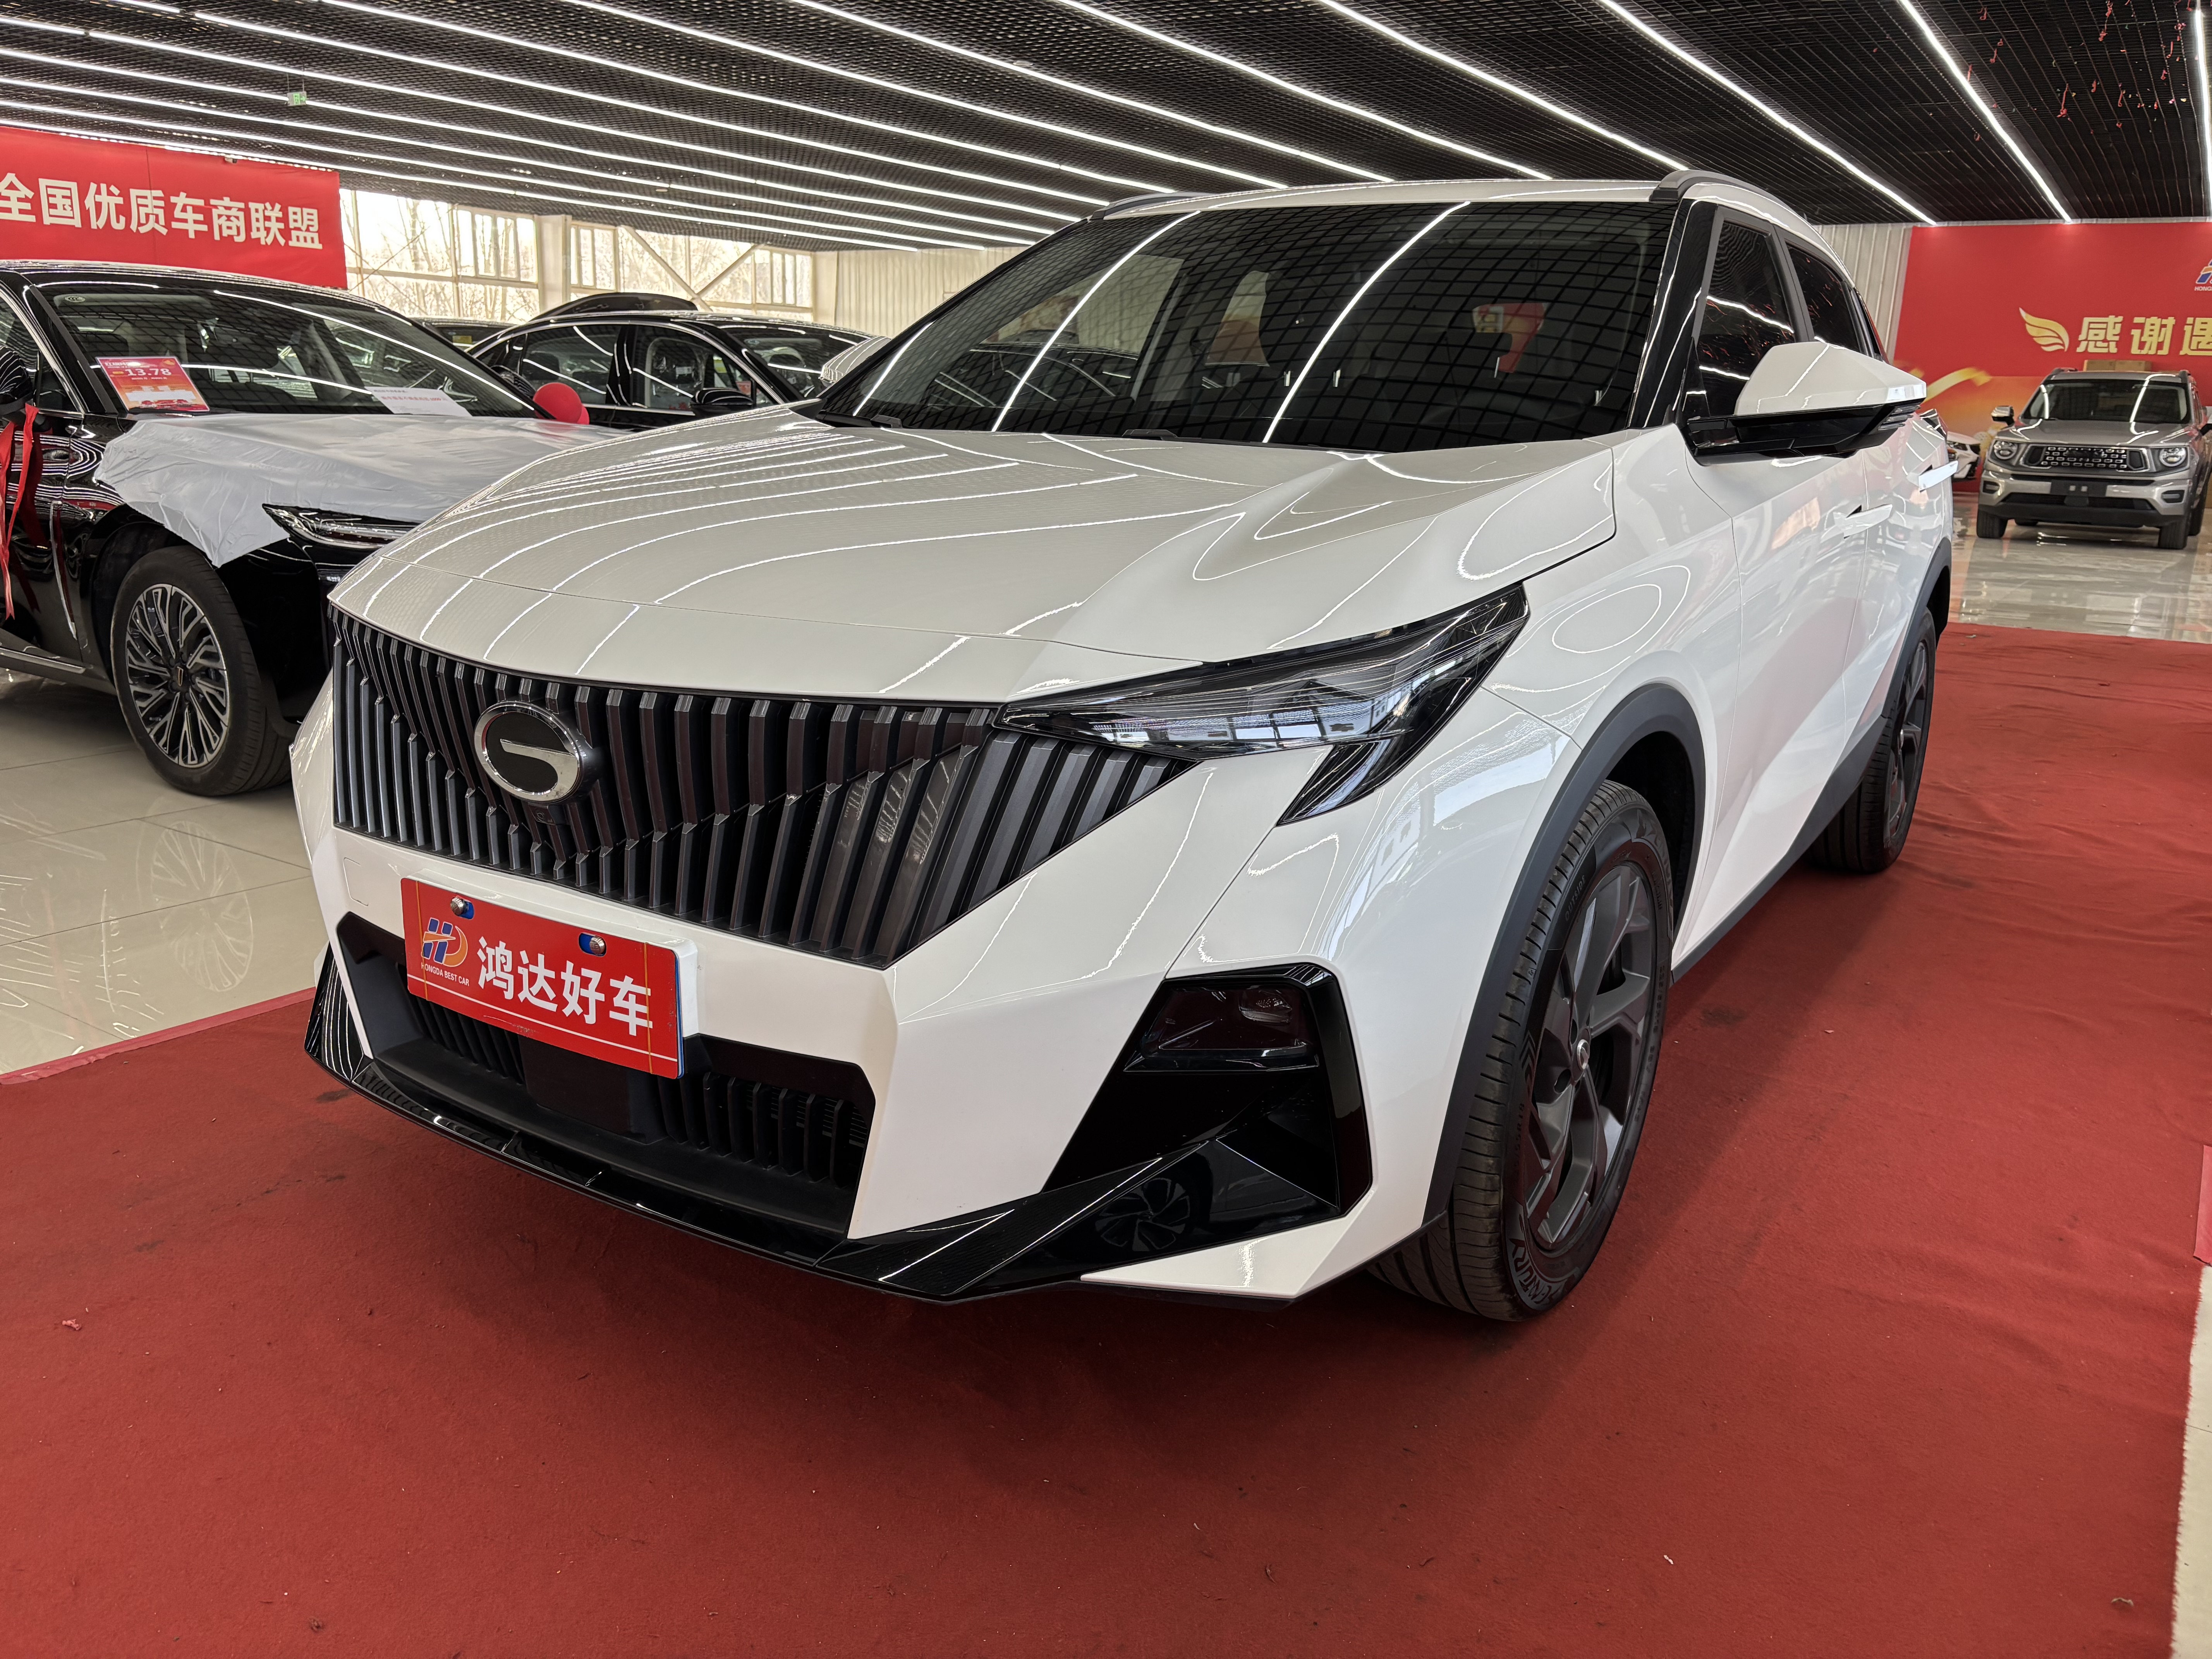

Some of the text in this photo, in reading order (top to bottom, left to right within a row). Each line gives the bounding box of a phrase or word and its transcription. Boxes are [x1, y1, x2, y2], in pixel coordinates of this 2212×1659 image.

[0, 173, 323, 249] 全国优质车商联盟
[2076, 315, 2212, 356] 感谢遇
[1565, 875, 1585, 921] OUTSIDE
[421, 962, 469, 986] HONGDA BEST CAR
[477, 936, 653, 1036] 鸿达好车
